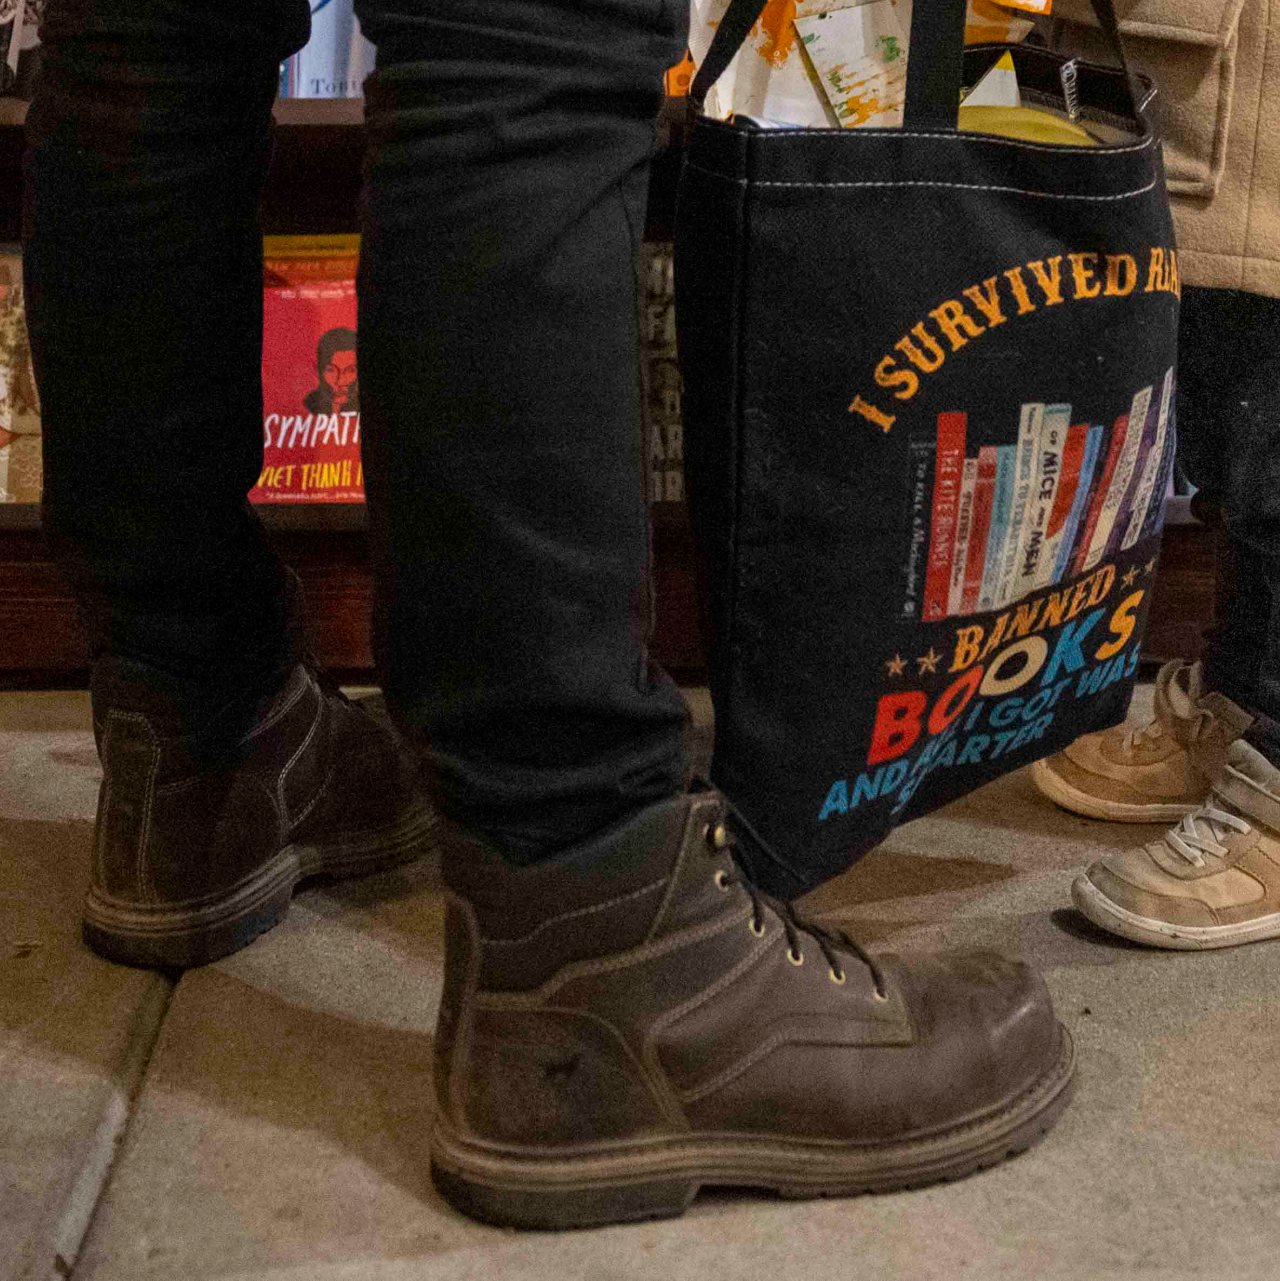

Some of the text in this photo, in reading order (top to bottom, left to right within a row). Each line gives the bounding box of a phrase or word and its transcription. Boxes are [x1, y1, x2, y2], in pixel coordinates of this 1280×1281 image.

[848, 251, 1139, 434] I SURVIVED
[1039, 451, 1059, 501] MICE
[1021, 530, 1044, 578] MEN
[867, 589, 1146, 767] BOOKS
[947, 563, 1117, 673] BANNED
[818, 759, 910, 822] AND
[988, 677, 1072, 728] GOT
